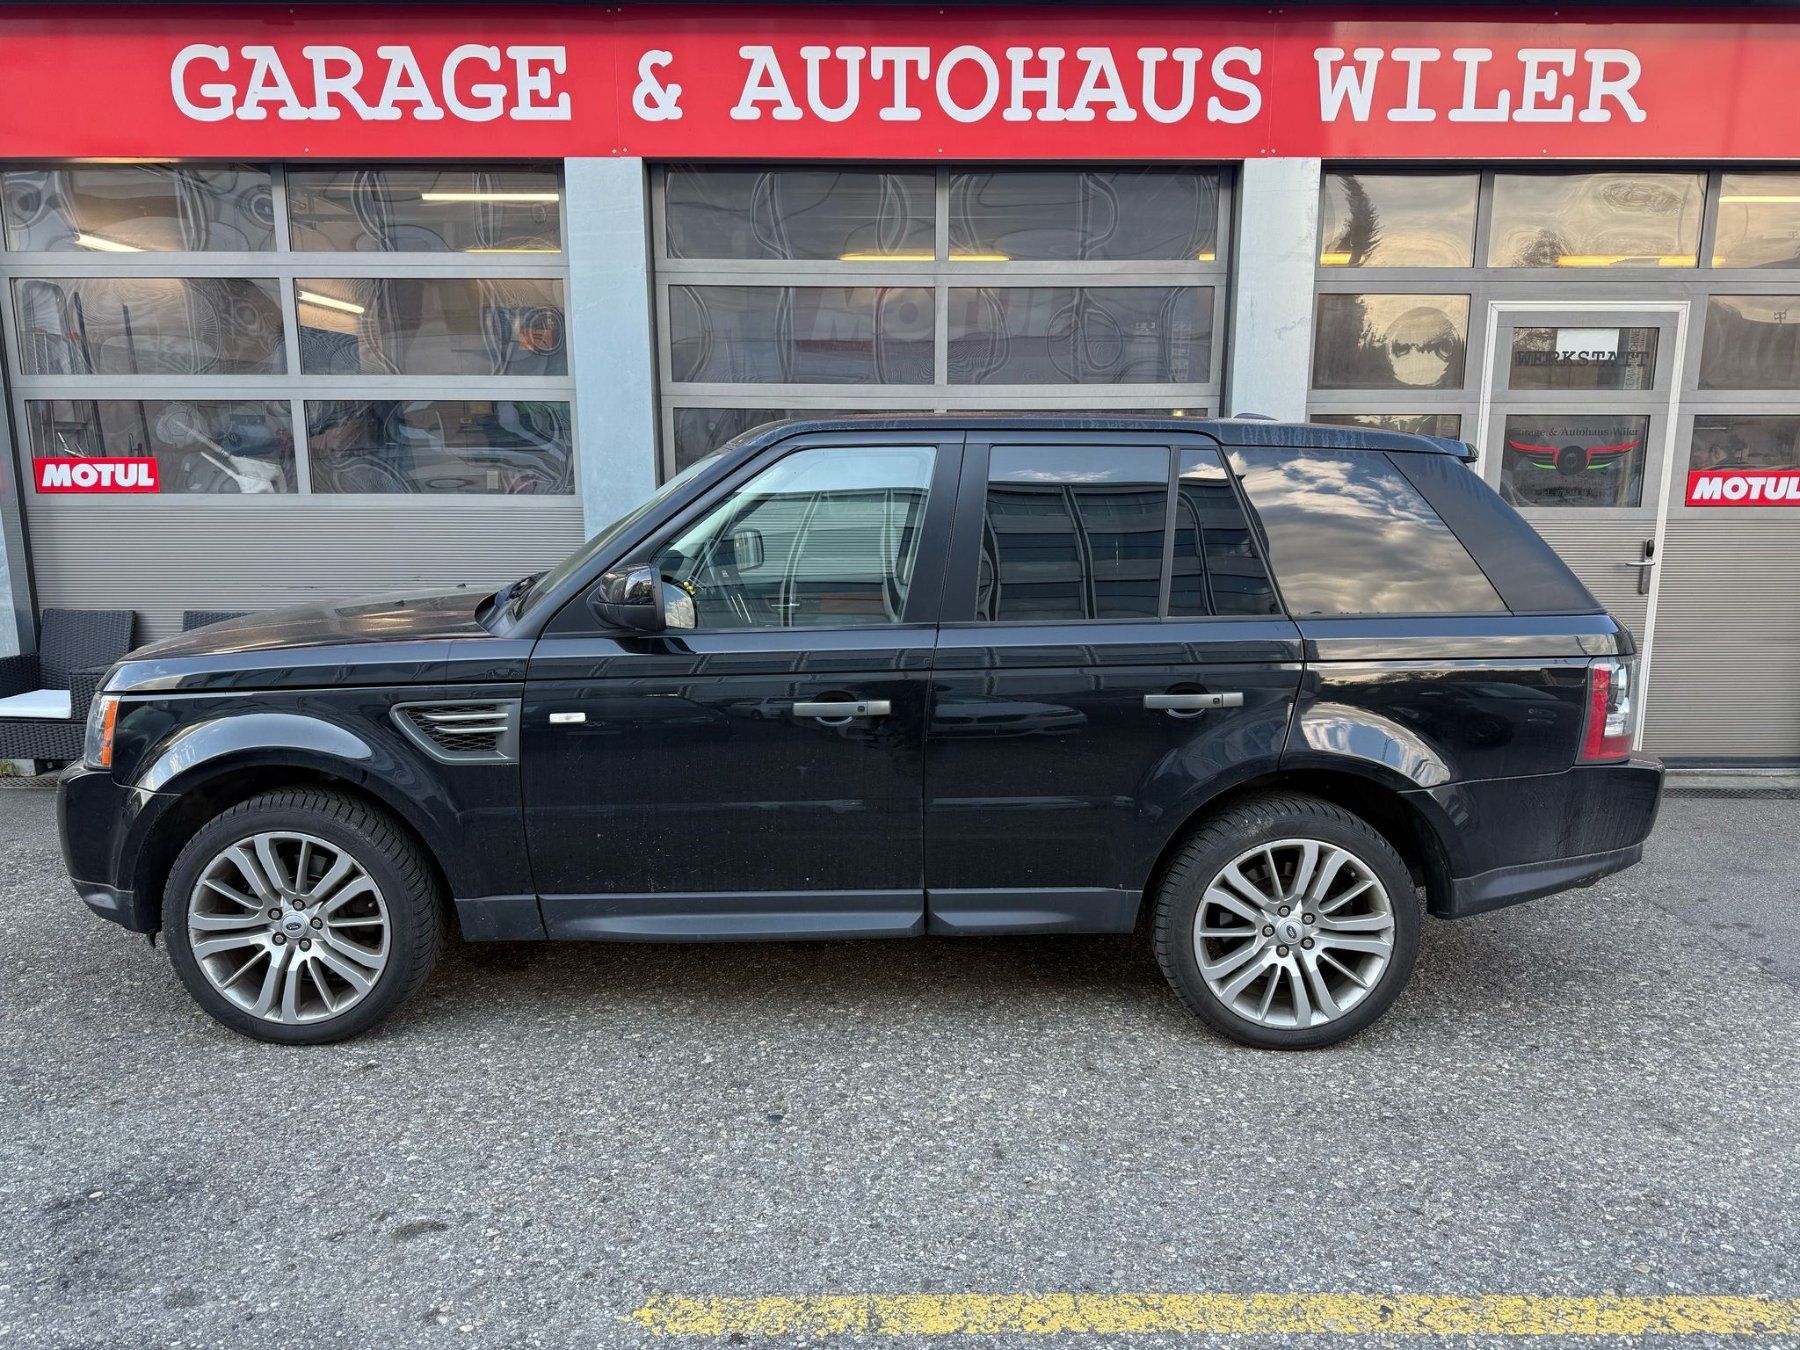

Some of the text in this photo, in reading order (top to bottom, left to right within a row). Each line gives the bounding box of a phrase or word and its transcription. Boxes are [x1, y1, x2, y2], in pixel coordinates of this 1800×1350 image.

[170, 43, 1647, 124] GARAGE & AUTOHAUS WILER
[1515, 350, 1649, 367] WERKSTATT
[1548, 427, 1558, 437] &
[1561, 427, 1608, 437] Autohaus
[1613, 427, 1639, 437] Wiler
[41, 463, 155, 487] MOTUL
[1691, 476, 1800, 500] MOTUL
